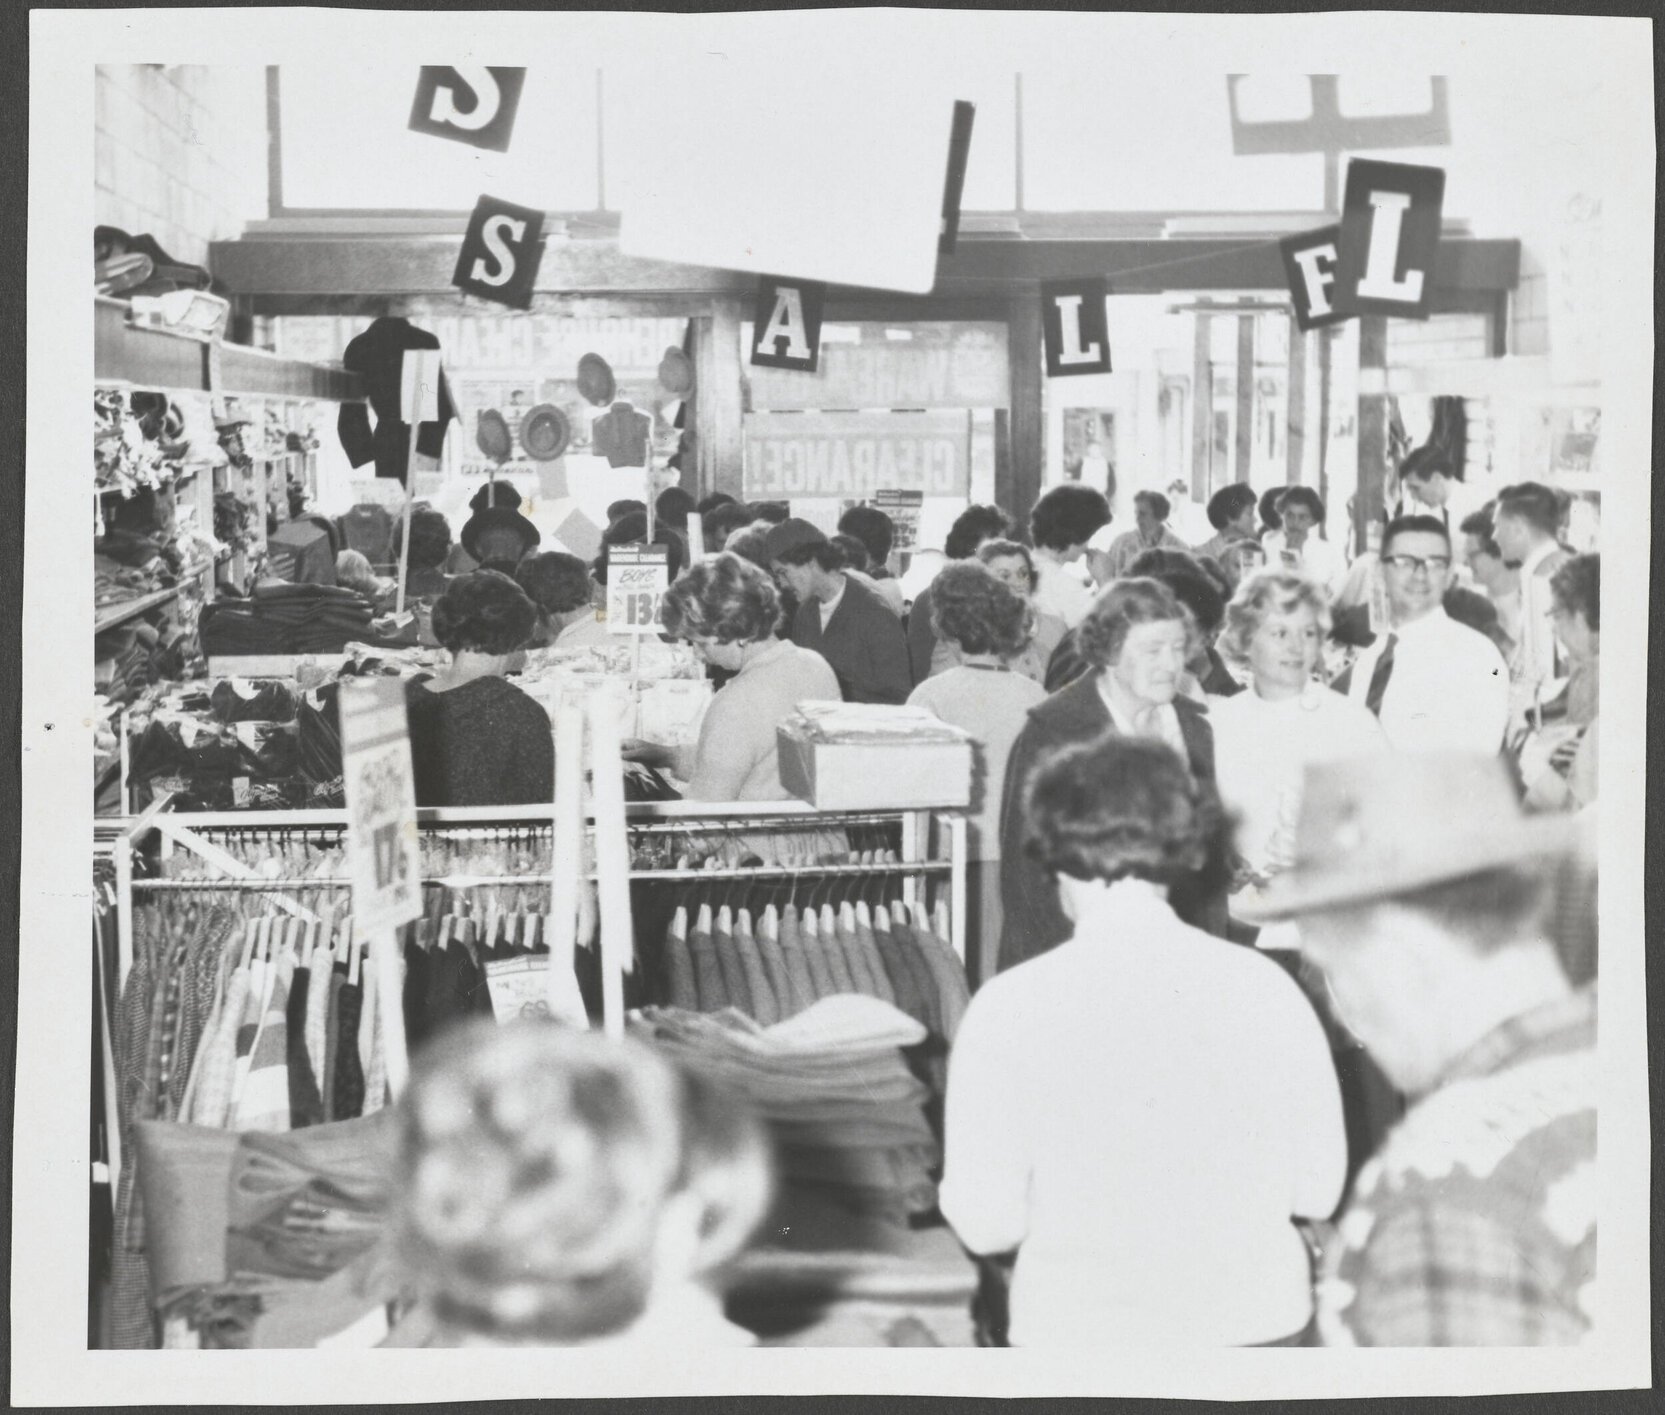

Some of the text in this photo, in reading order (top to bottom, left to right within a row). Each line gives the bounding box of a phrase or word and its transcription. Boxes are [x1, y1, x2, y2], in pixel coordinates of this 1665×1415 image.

[470, 214, 527, 286] S
[757, 287, 812, 360] A
[1055, 294, 1102, 366] L
[1356, 191, 1424, 303] L
